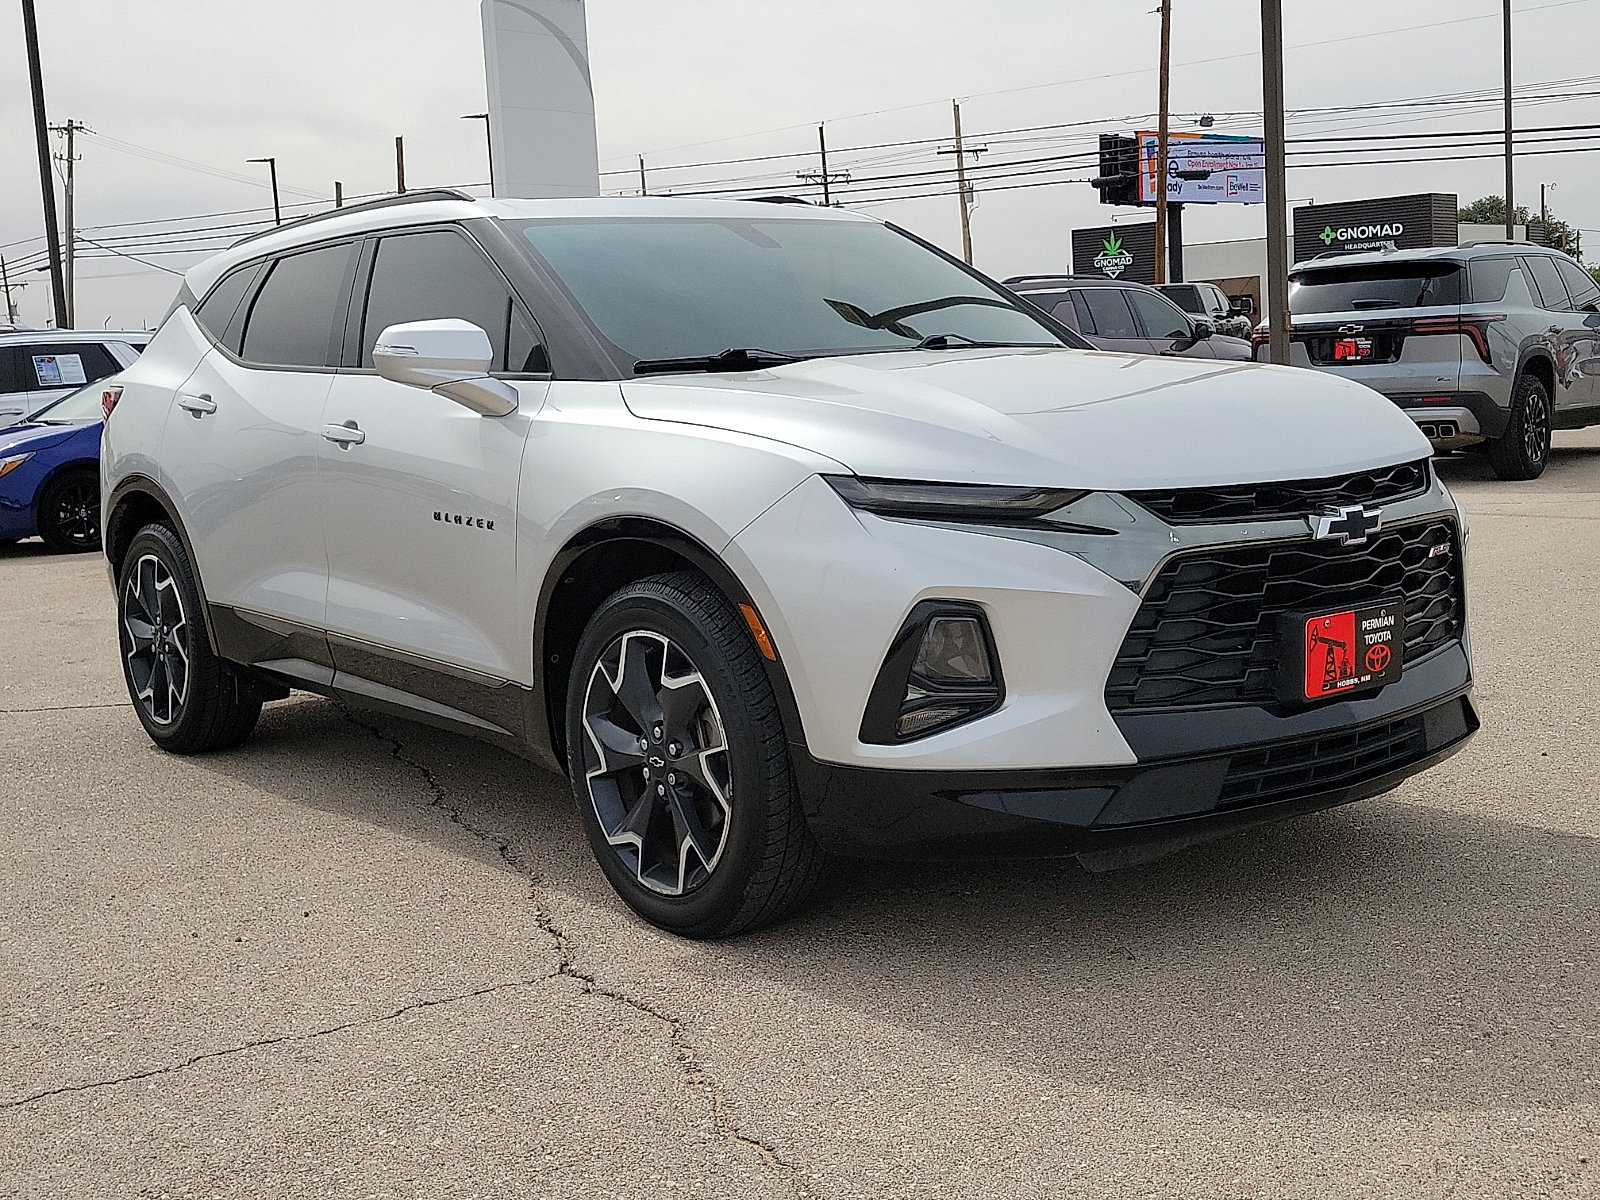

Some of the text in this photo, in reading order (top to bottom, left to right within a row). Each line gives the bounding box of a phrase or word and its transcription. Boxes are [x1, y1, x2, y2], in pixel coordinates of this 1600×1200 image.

[1167, 181, 1183, 194] ady
[1337, 223, 1403, 240] GNOMAD
[1094, 257, 1133, 268] GNOMAD
[433, 511, 495, 531] BLAZER
[1428, 543, 1450, 558] RS
[1361, 614, 1395, 631] PERMIAN
[1363, 630, 1392, 645] TOYOTA
[1337, 674, 1371, 688] HOBBS, NM
